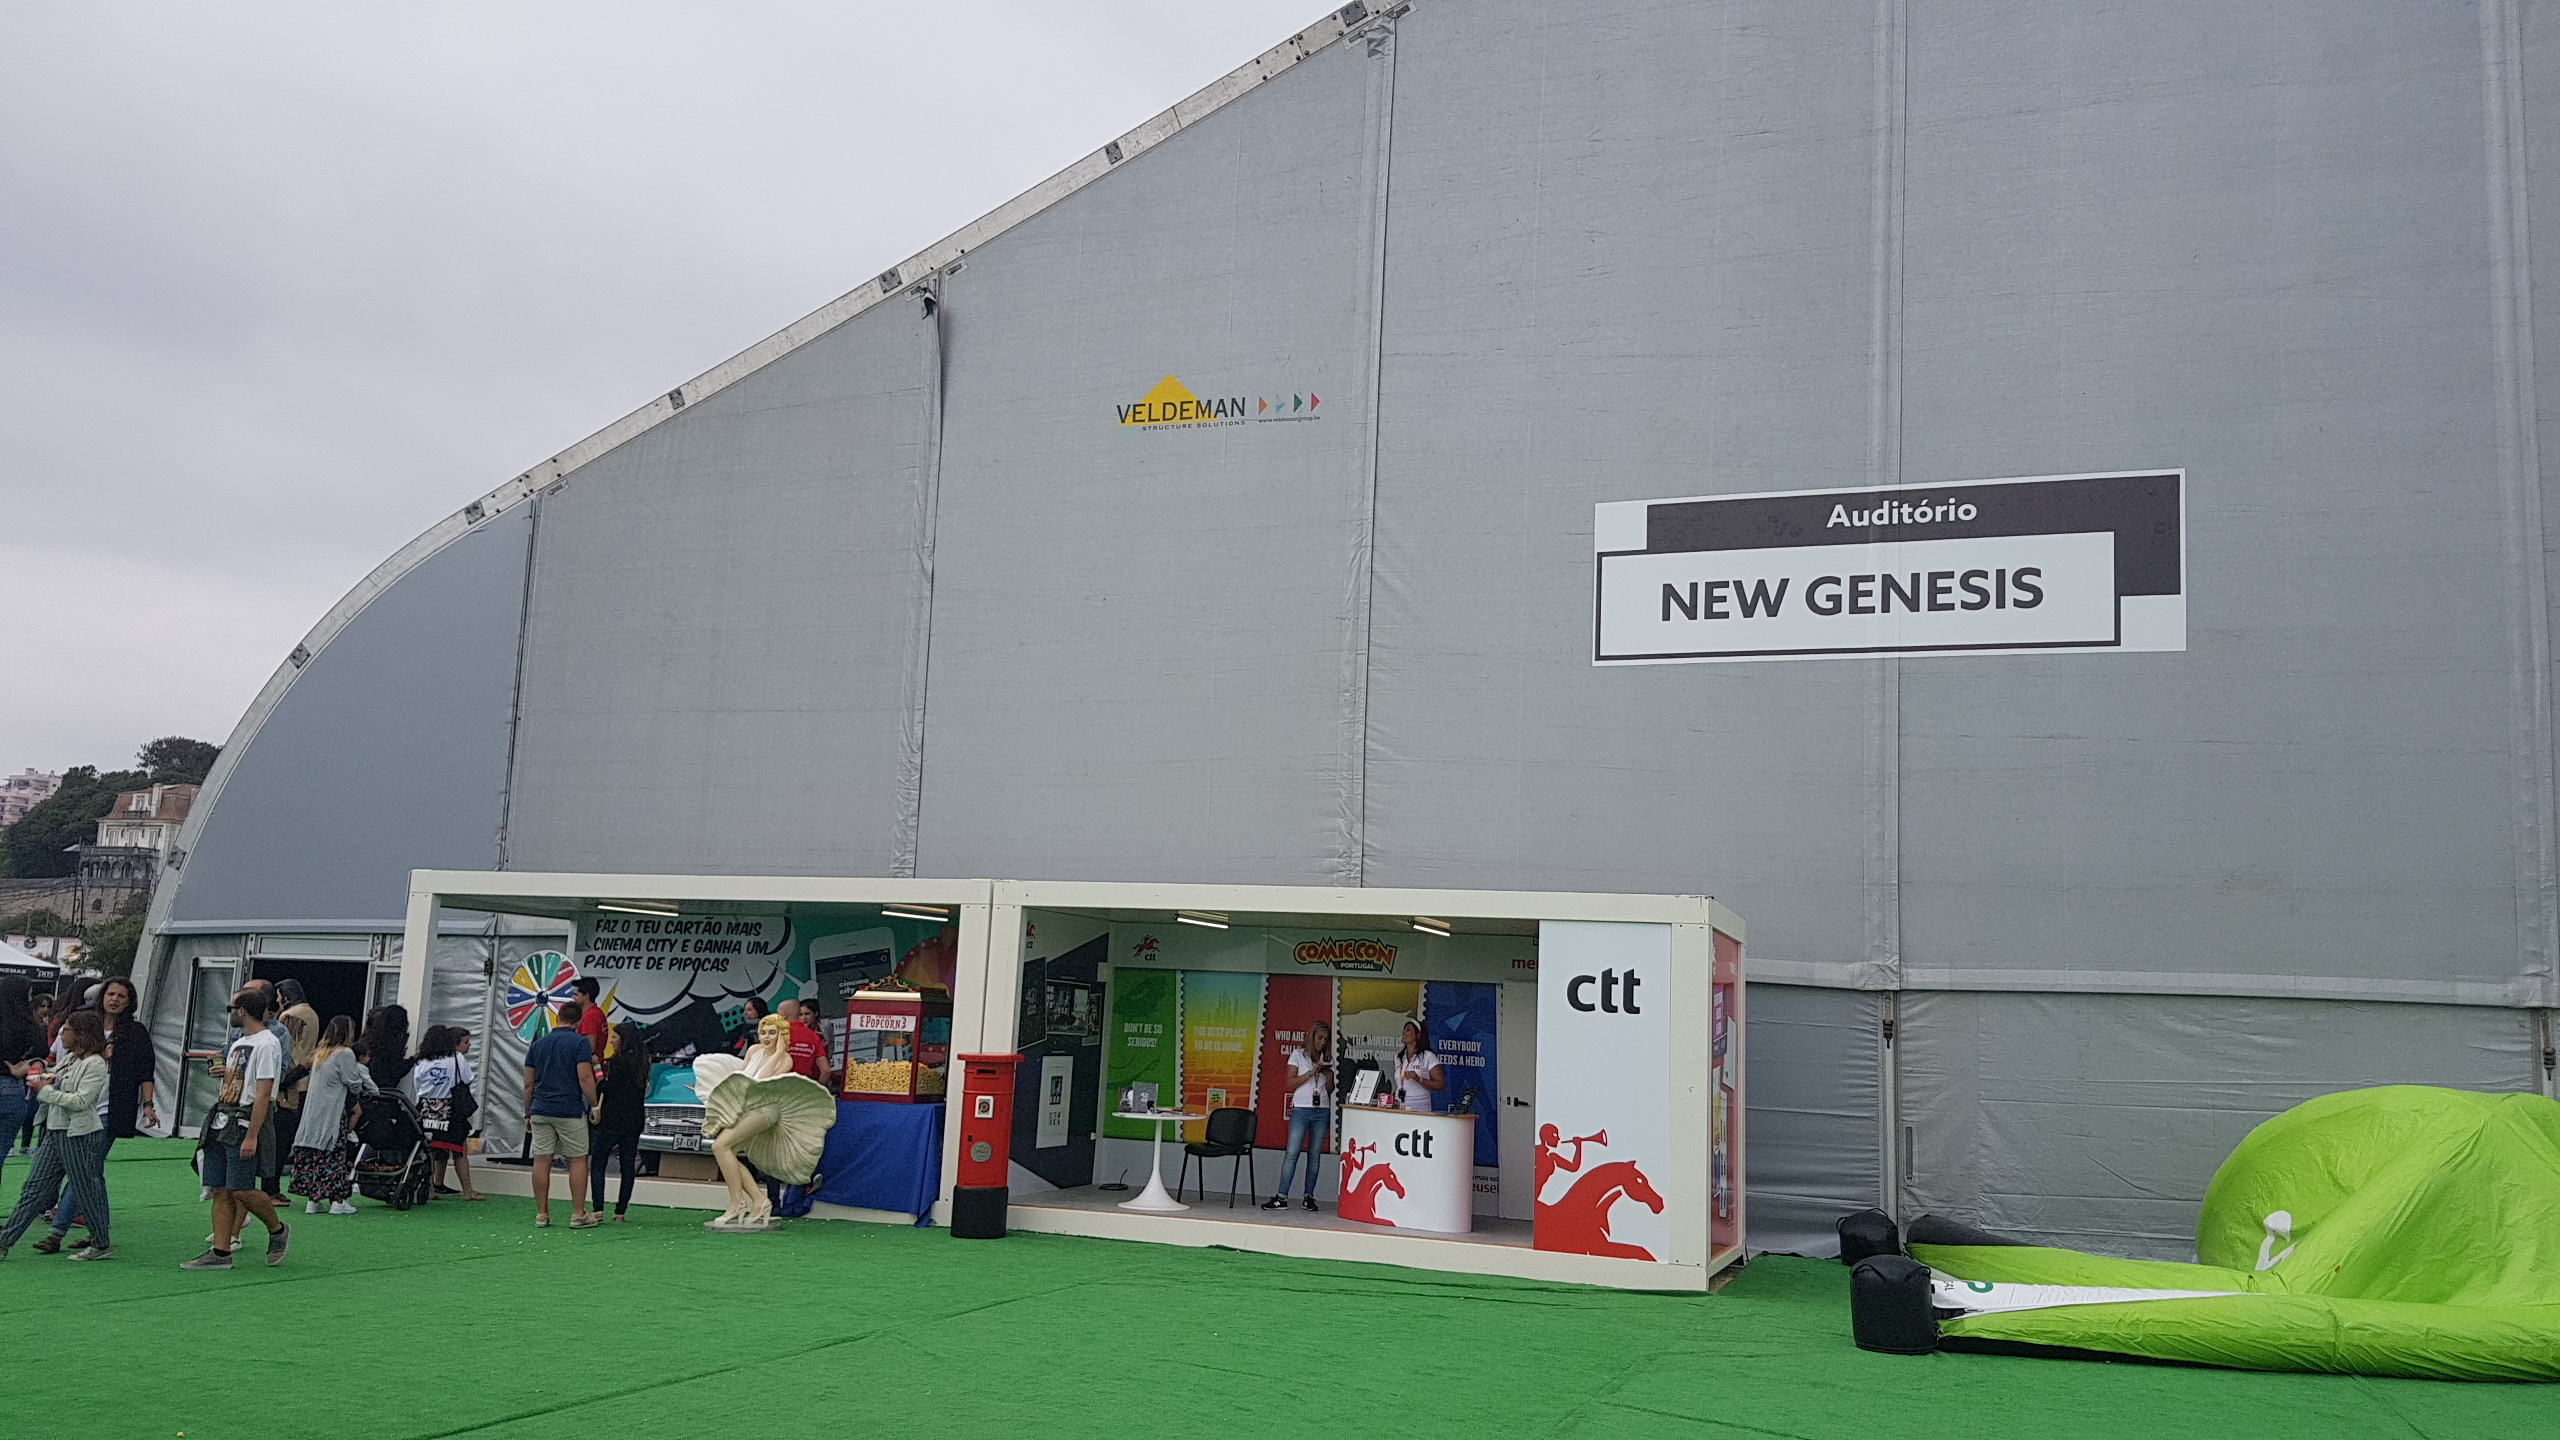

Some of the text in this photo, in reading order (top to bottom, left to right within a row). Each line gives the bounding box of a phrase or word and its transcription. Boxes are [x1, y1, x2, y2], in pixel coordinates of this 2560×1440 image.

[1116, 396, 1246, 424] VELDEMAN
[1142, 420, 1246, 432] STRUCTURE SOLUTIONS
[1826, 497, 1978, 529] Auditório
[1661, 566, 2045, 622] NEW GENESIS
[595, 916, 762, 937] FAZ O TEU CARTÃO MAIS
[593, 937, 769, 956] CINEMA CITY E GANHA UM
[583, 955, 730, 972] PACOTE DE PIPOCAS
[1295, 937, 1397, 974] COMIC CON
[1566, 967, 1641, 1015] ctt
[1124, 1022, 1163, 1034] DON'T BE SO
[1275, 1030, 1291, 1041] WHO
[1292, 1031, 1305, 1042] ARE
[1127, 1036, 1157, 1048] SERIOUS!
[1352, 1034, 1367, 1046] THE
[1367, 1035, 1394, 1048] WINTER
[1438, 1040, 1482, 1052] EVERYBODY
[1344, 1048, 1373, 1060] ALMOST
[1459, 1055, 1465, 1066] A
[1465, 1056, 1486, 1068] HERO
[1394, 1128, 1434, 1159] ctt
